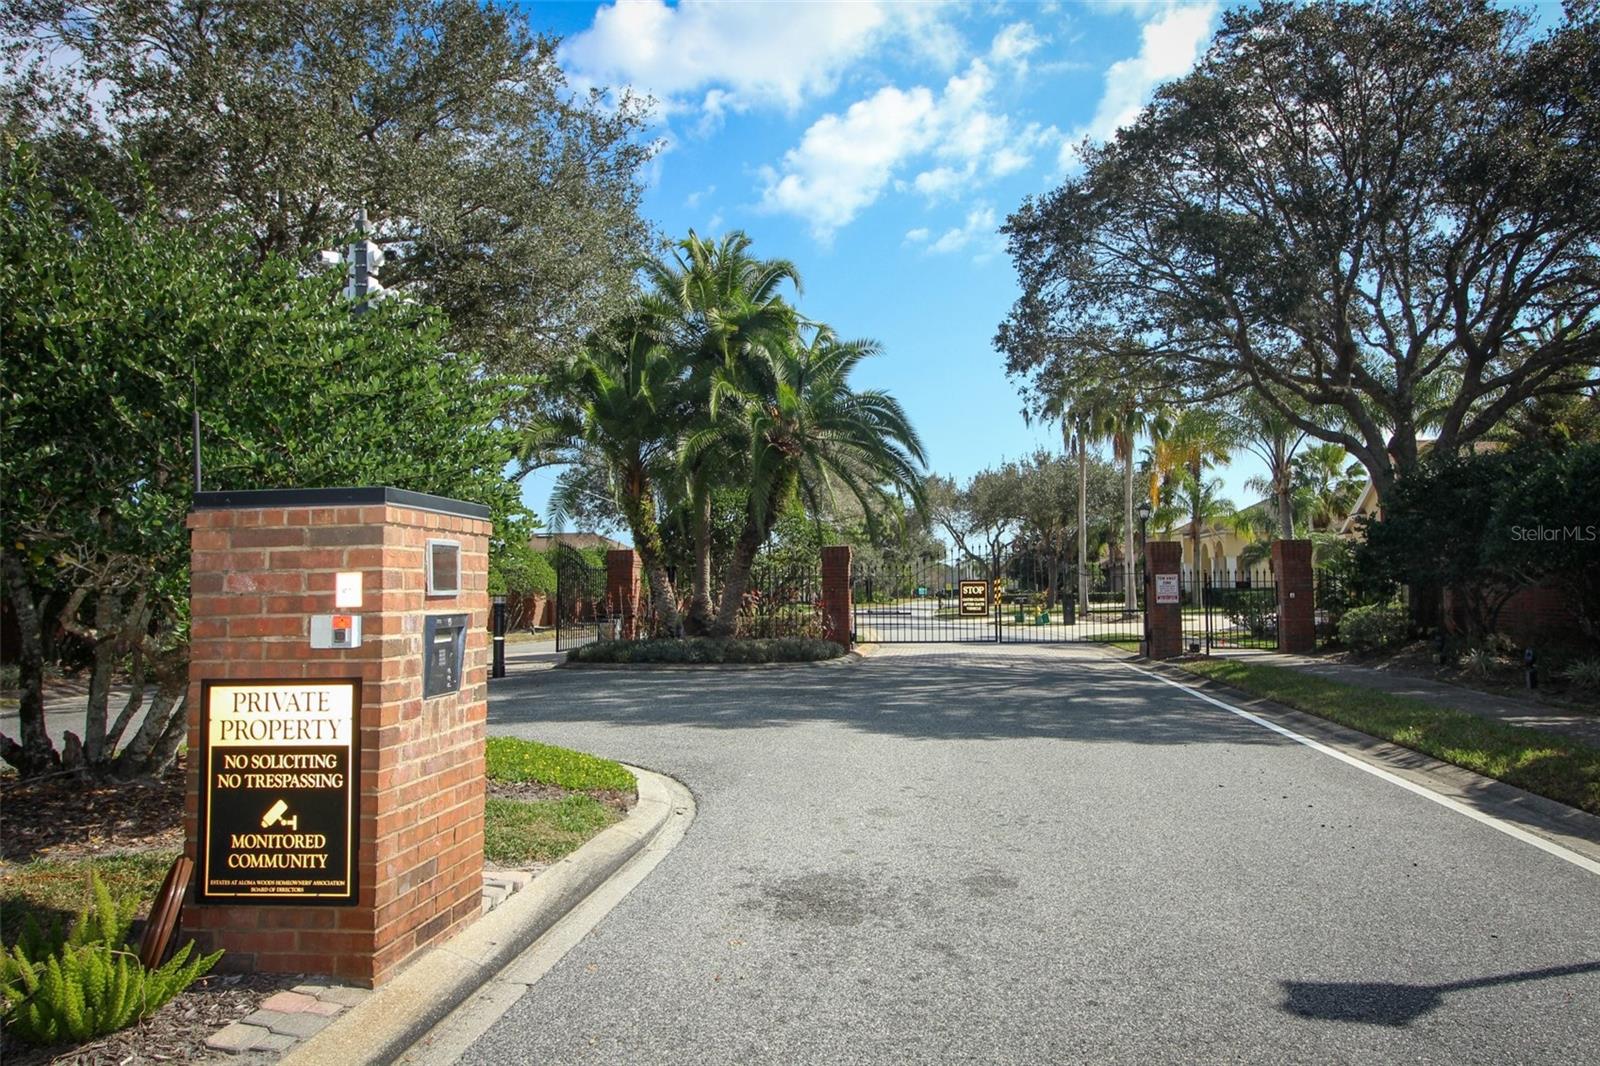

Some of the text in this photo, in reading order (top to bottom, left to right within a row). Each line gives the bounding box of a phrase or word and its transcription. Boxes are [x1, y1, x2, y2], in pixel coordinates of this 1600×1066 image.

[963, 586, 984, 594] STOP
[233, 692, 330, 712] PRIVATE
[220, 719, 342, 740] PROPERTY
[224, 754, 337, 769] NO SOLICITING
[218, 774, 344, 788] NO TRESPASSING
[231, 834, 326, 849] MONITORED
[228, 854, 328, 868] COMMUNITY
